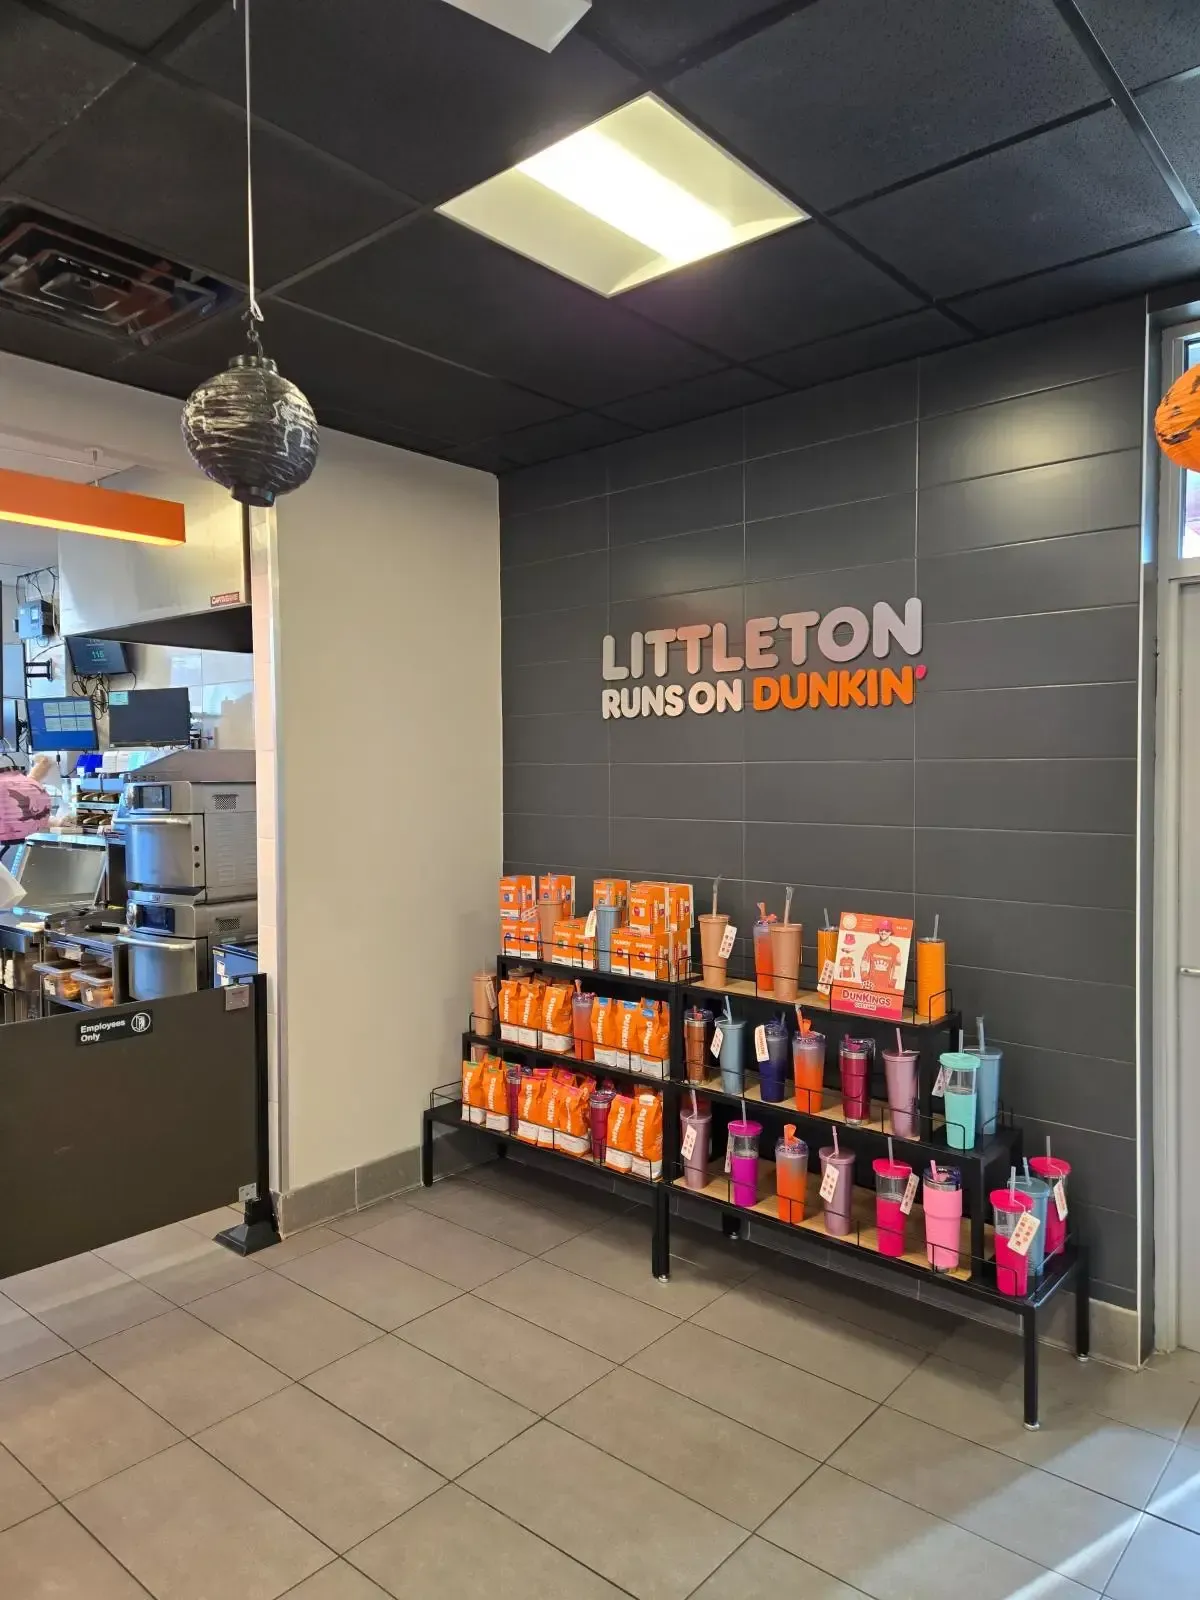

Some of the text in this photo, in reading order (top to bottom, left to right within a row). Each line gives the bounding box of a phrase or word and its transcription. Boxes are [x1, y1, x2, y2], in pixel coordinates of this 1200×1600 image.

[603, 597, 922, 681] LITTLETON
[602, 665, 926, 720] RUNS ON DUNKIN'
[842, 989, 891, 1006] DUNKINGS
[80, 1020, 126, 1034] Employees
[80, 1033, 101, 1042] Only
